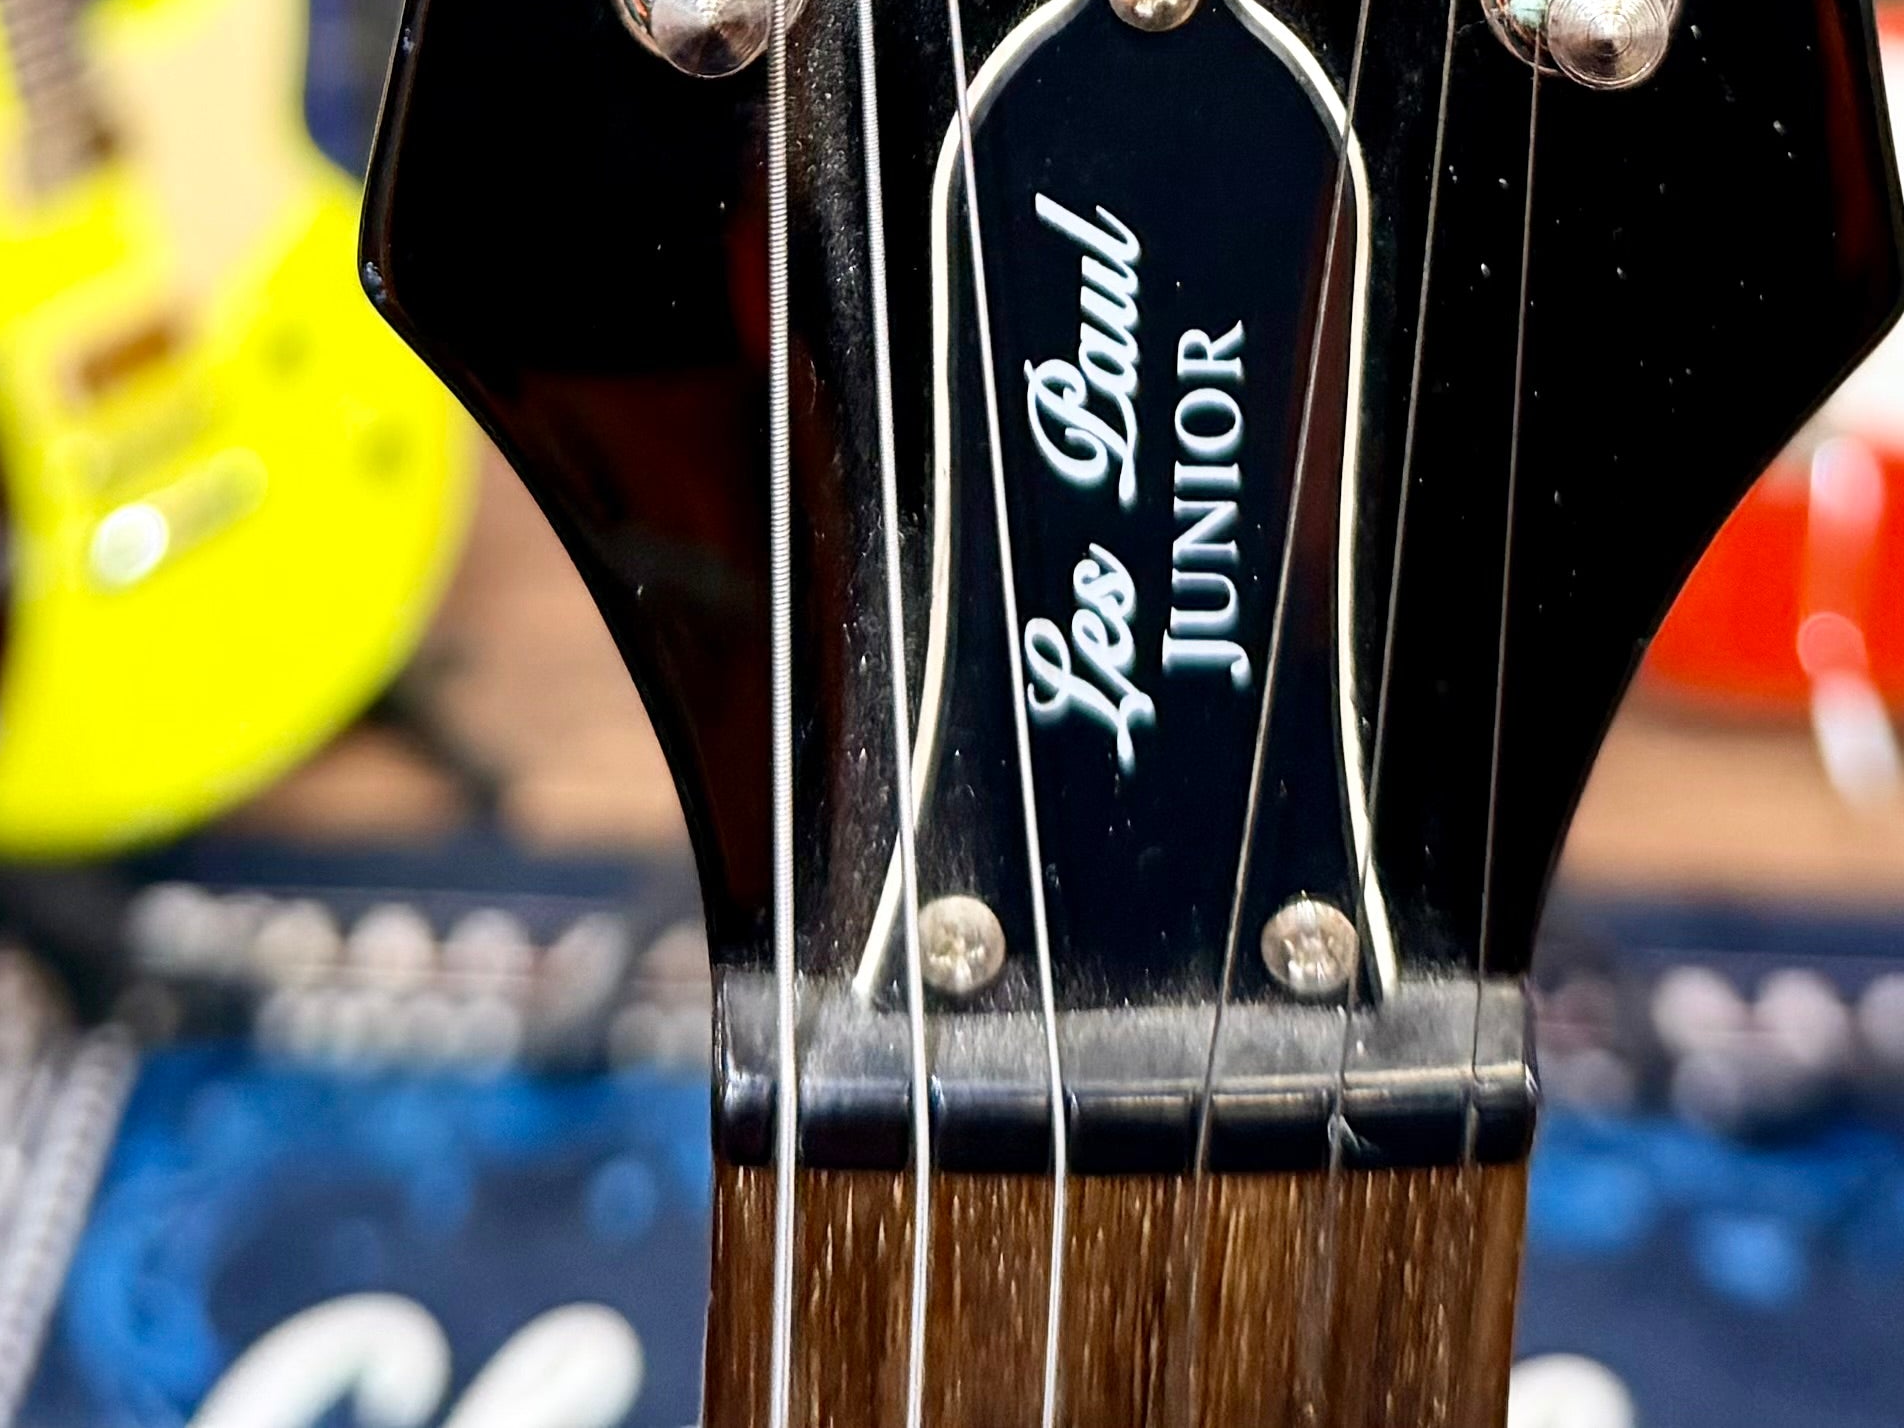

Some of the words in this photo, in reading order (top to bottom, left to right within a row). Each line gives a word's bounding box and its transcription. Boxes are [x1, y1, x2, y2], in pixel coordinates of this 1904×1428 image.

[1024, 190, 1142, 510] Paul
[1161, 318, 1250, 691] JUNIOR
[1024, 541, 1157, 774] Les
